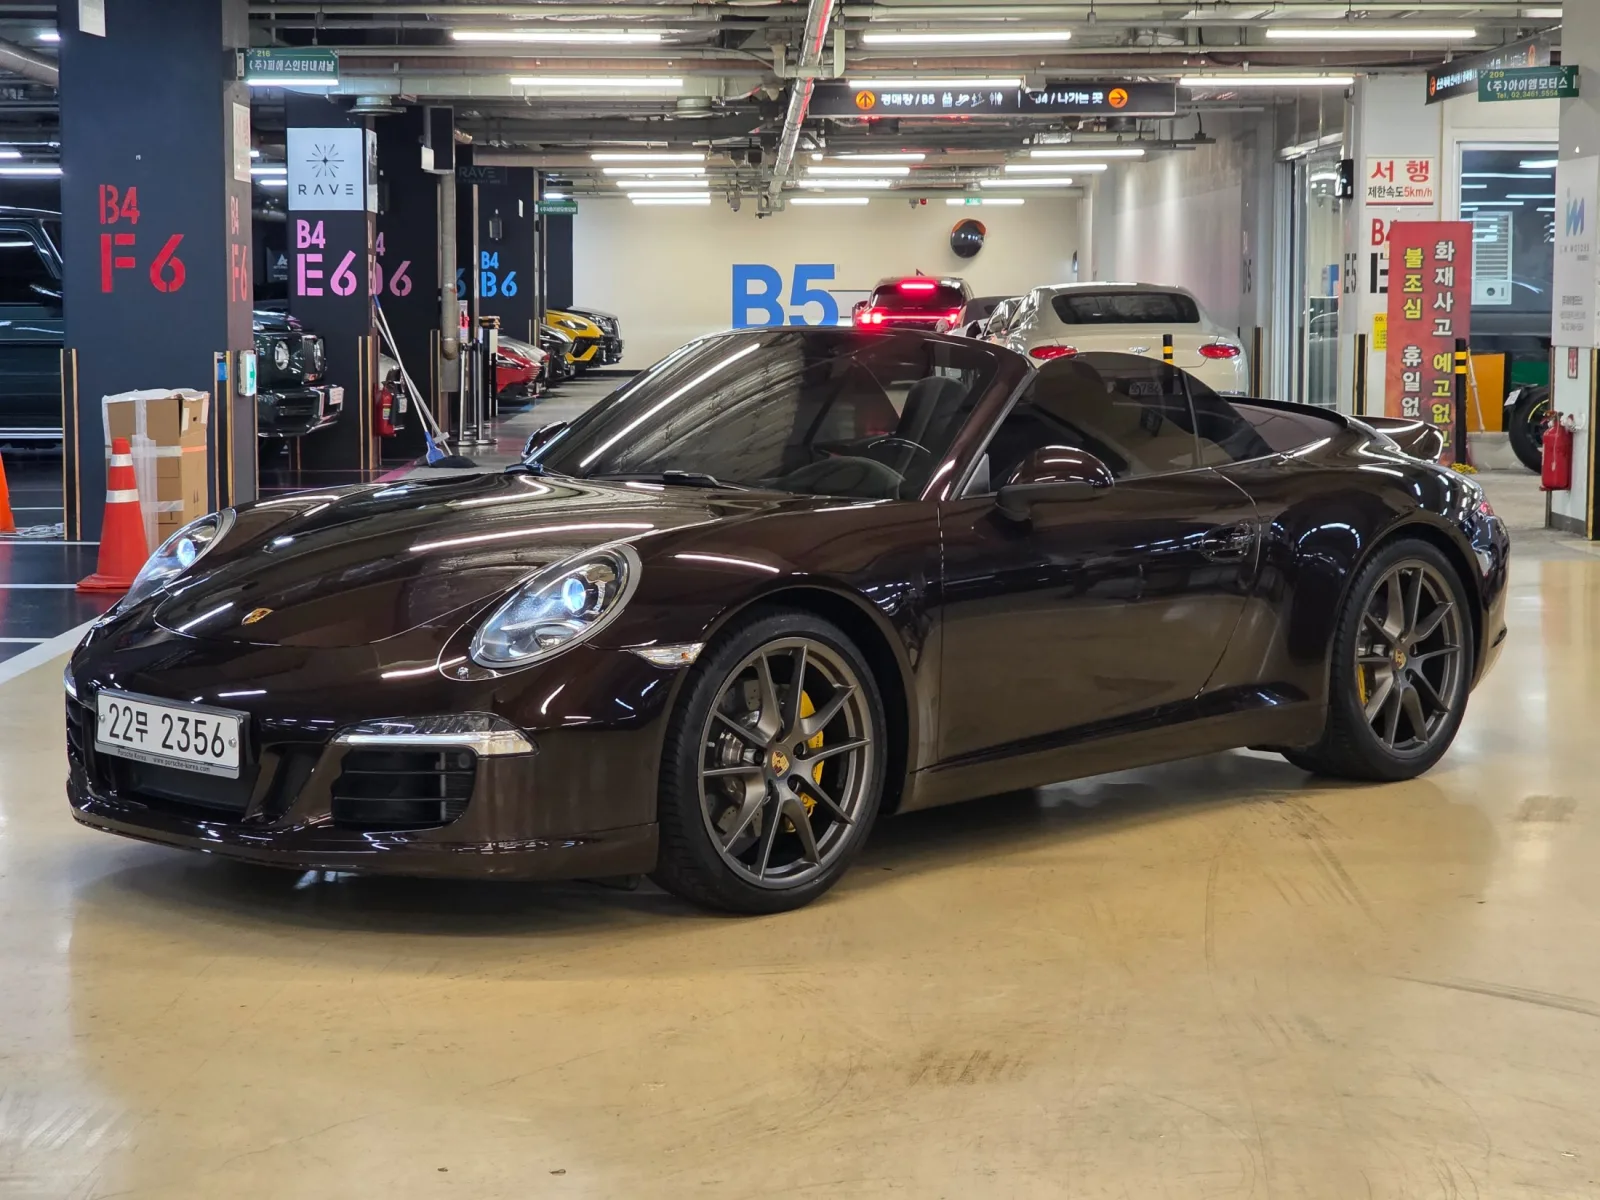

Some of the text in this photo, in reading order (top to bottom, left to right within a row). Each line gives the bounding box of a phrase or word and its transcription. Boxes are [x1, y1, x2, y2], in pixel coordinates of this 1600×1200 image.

[1489, 71, 1504, 79] 209
[298, 184, 354, 195] RAVE
[99, 184, 140, 224] B4
[297, 220, 326, 248] B4
[376, 232, 386, 256] 4
[481, 251, 499, 269] B4
[481, 271, 518, 297] B6
[732, 264, 839, 329] B5
[109, 703, 225, 758] 22무 2356
